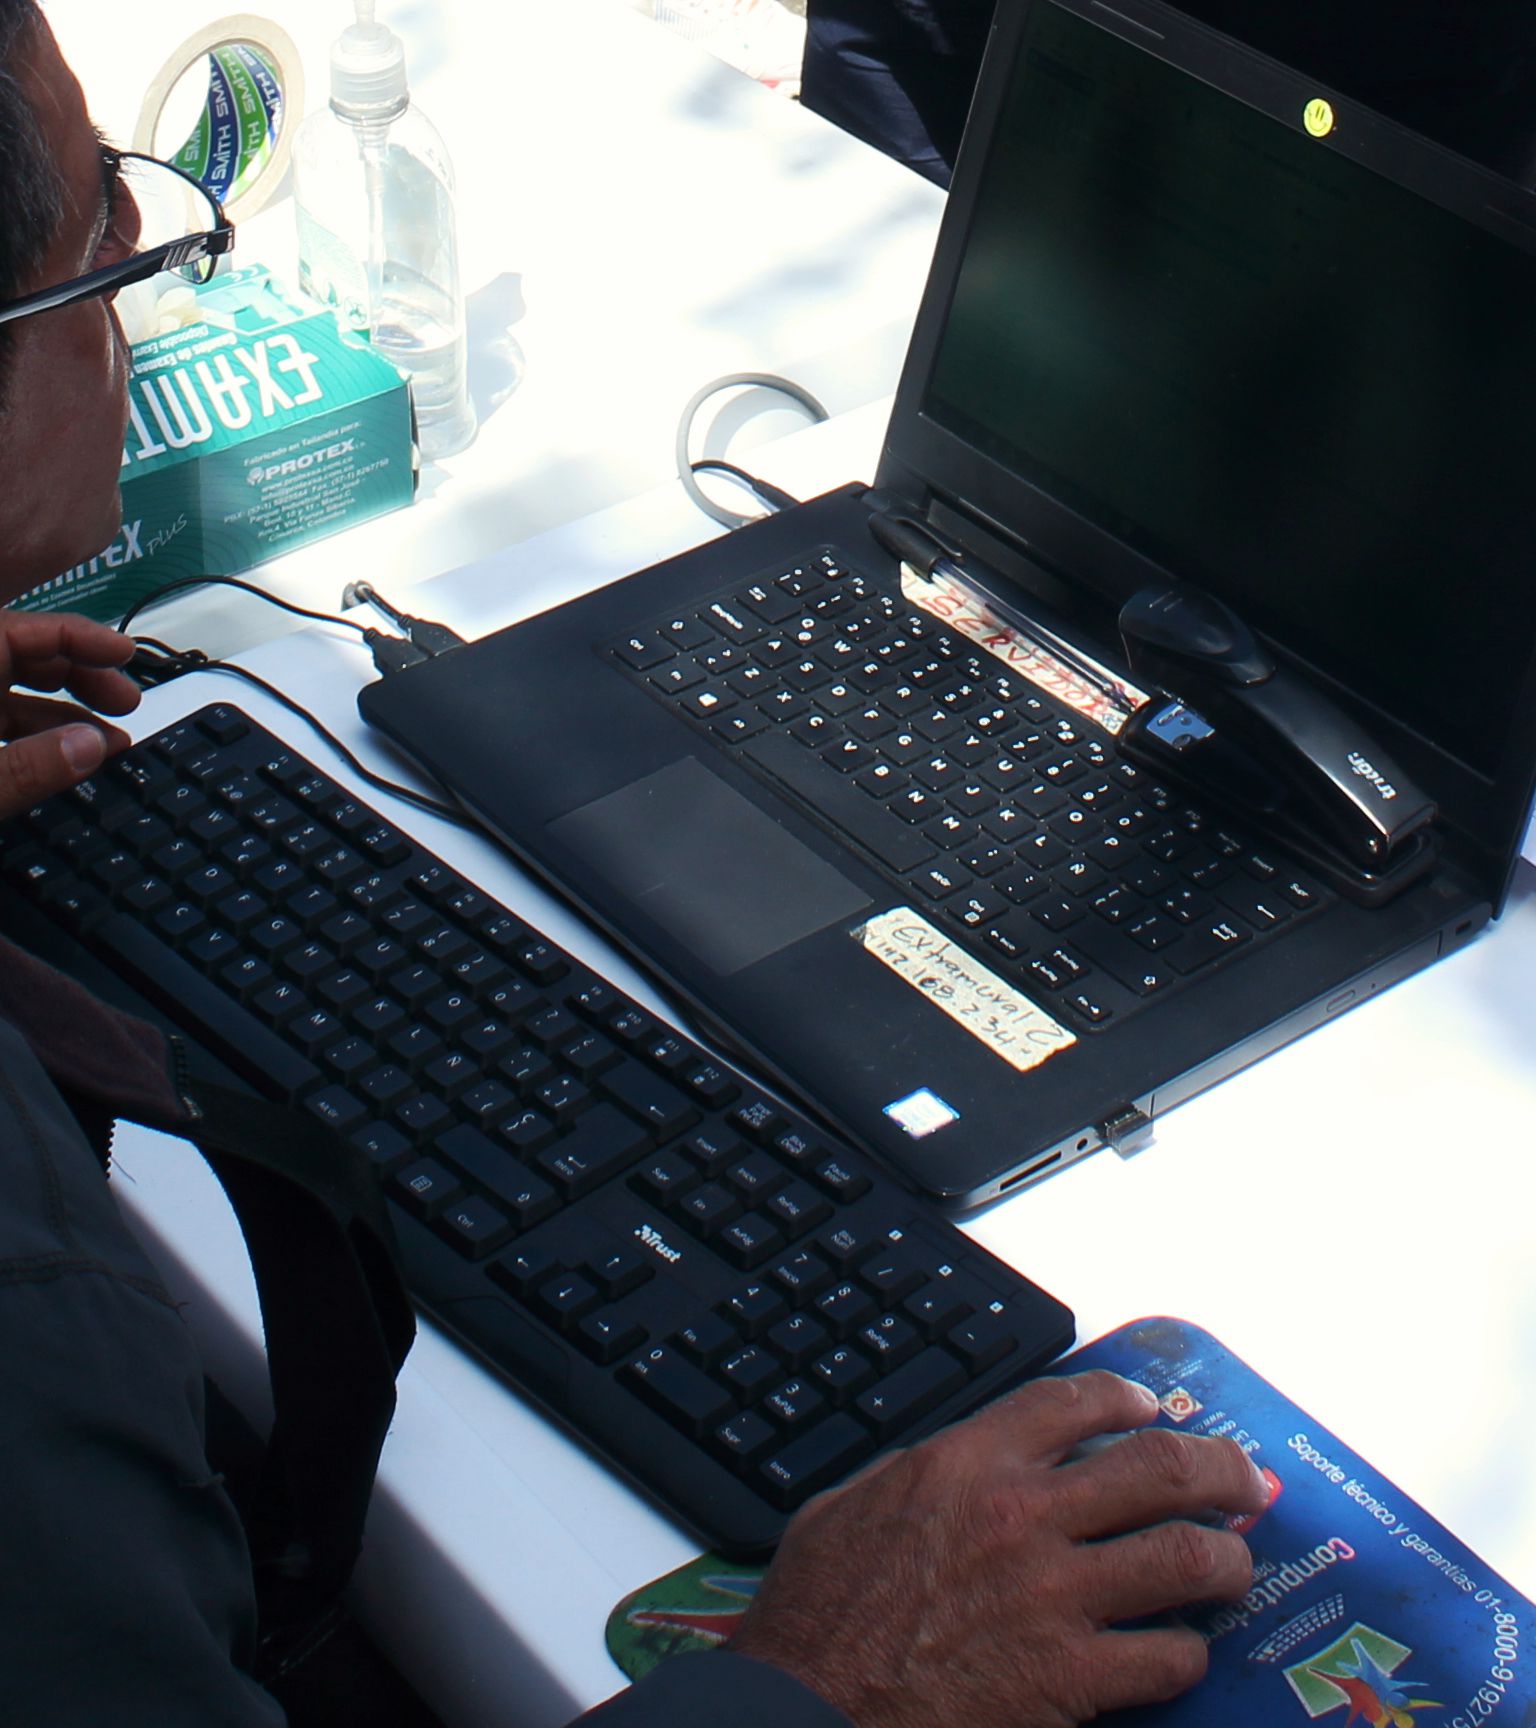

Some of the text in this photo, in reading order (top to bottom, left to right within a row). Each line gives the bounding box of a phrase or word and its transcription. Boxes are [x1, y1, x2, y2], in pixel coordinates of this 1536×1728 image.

[264, 437, 355, 480] PROTEX
[647, 1229, 682, 1263] Trust
[1287, 1432, 1346, 1484] Soporte
[1341, 1477, 1397, 1526] técnico
[1388, 1522, 1410, 1536] y
[1400, 1532, 1477, 1593] garantías
